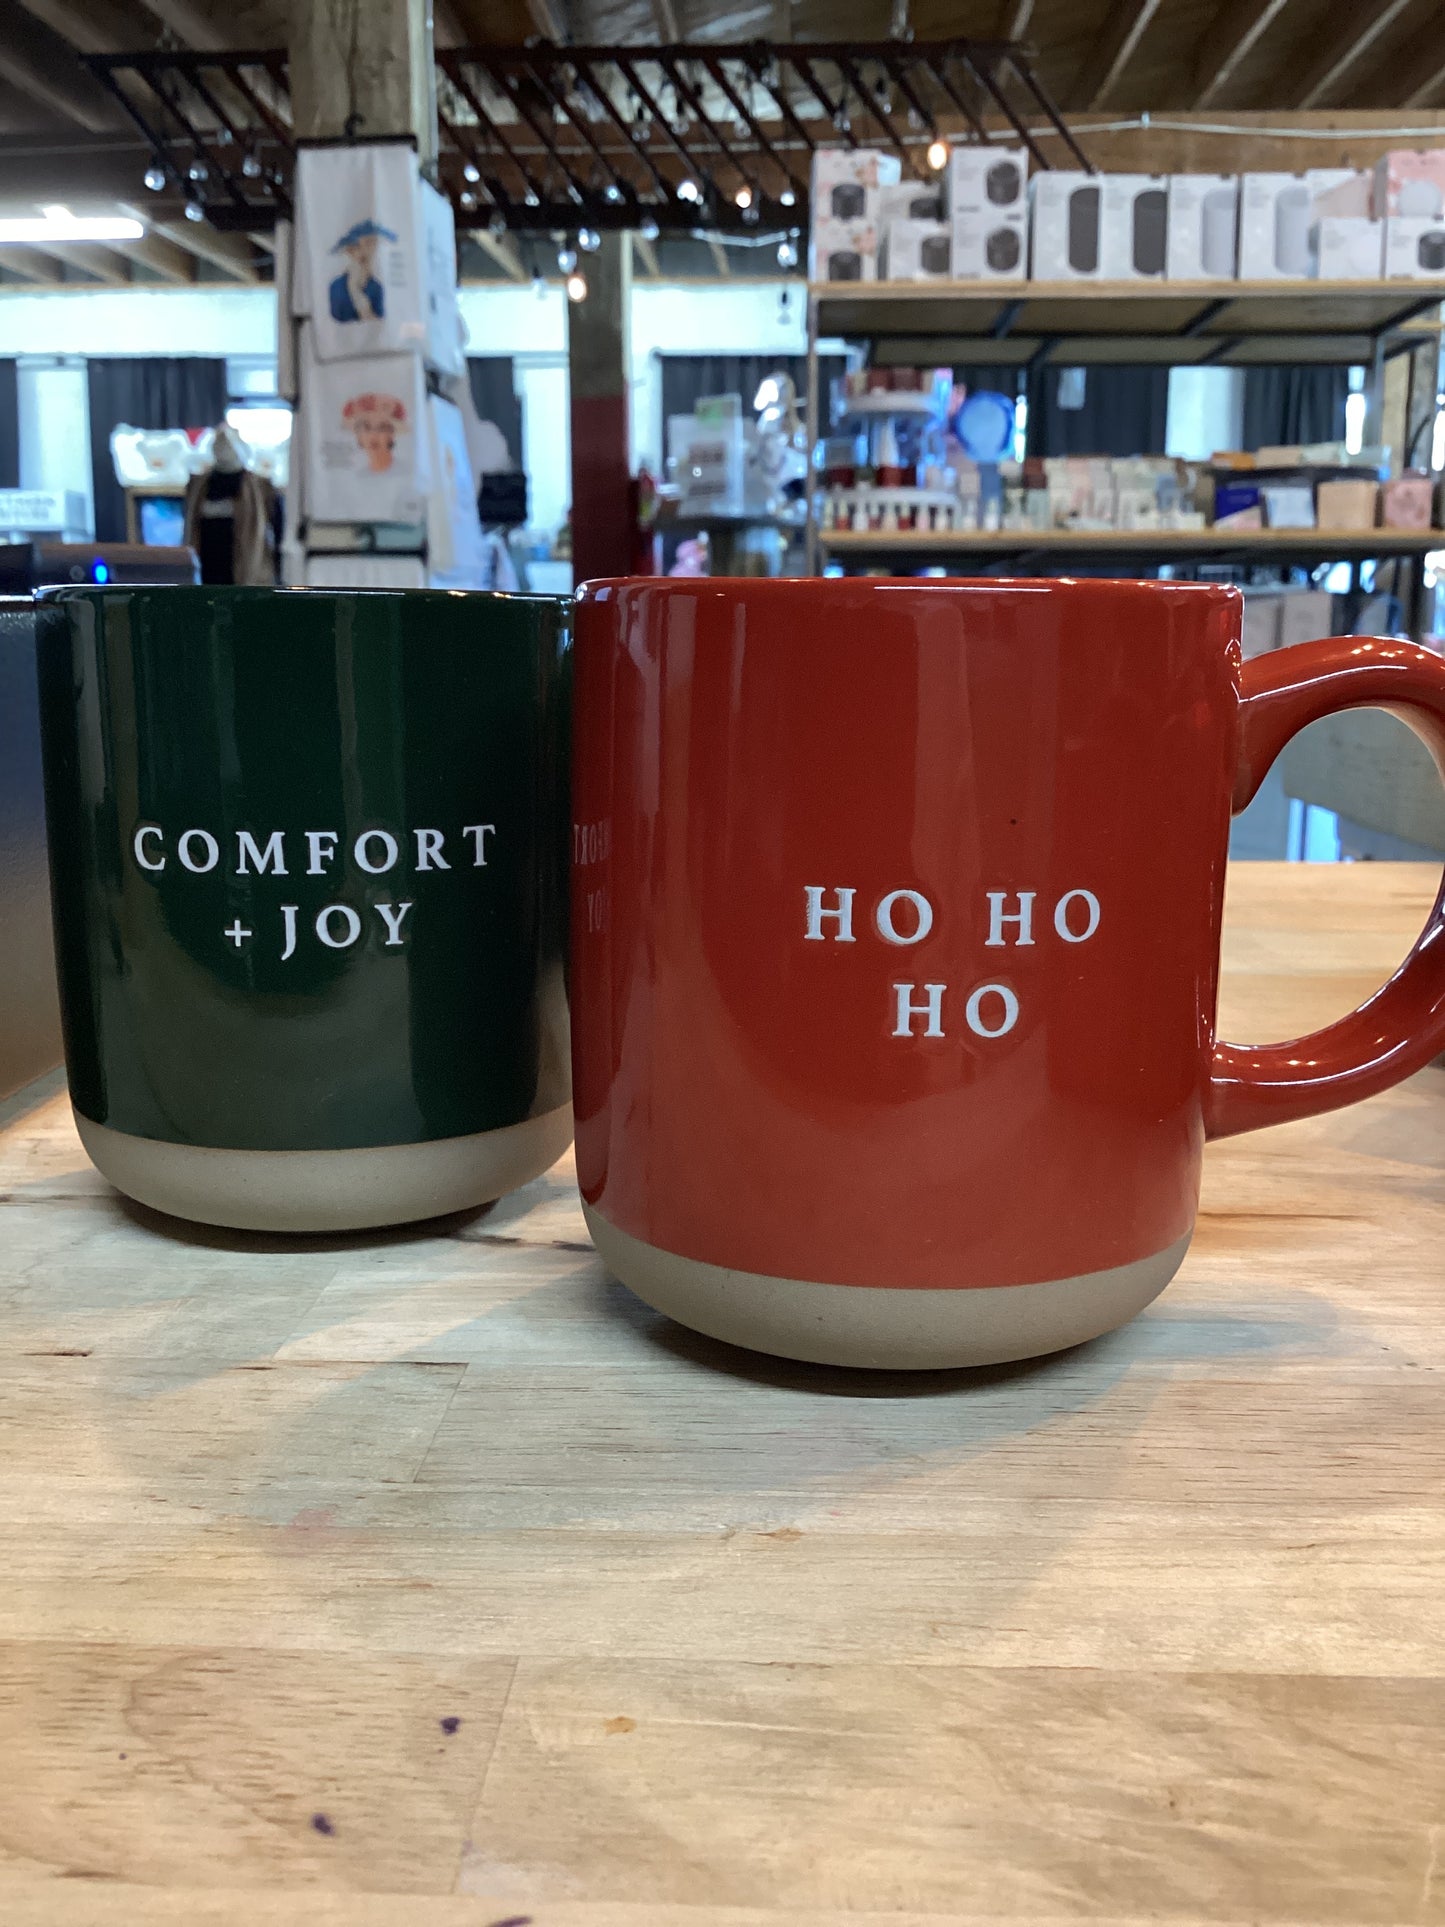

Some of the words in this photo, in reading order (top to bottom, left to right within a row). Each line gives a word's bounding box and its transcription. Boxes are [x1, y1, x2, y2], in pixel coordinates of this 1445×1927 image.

[133, 824, 497, 875] COMFORT
[224, 919, 252, 948] +
[280, 902, 414, 961] JOY
[803, 885, 934, 945] HO
[984, 889, 1101, 946] HO
[891, 983, 1020, 1038] HO
